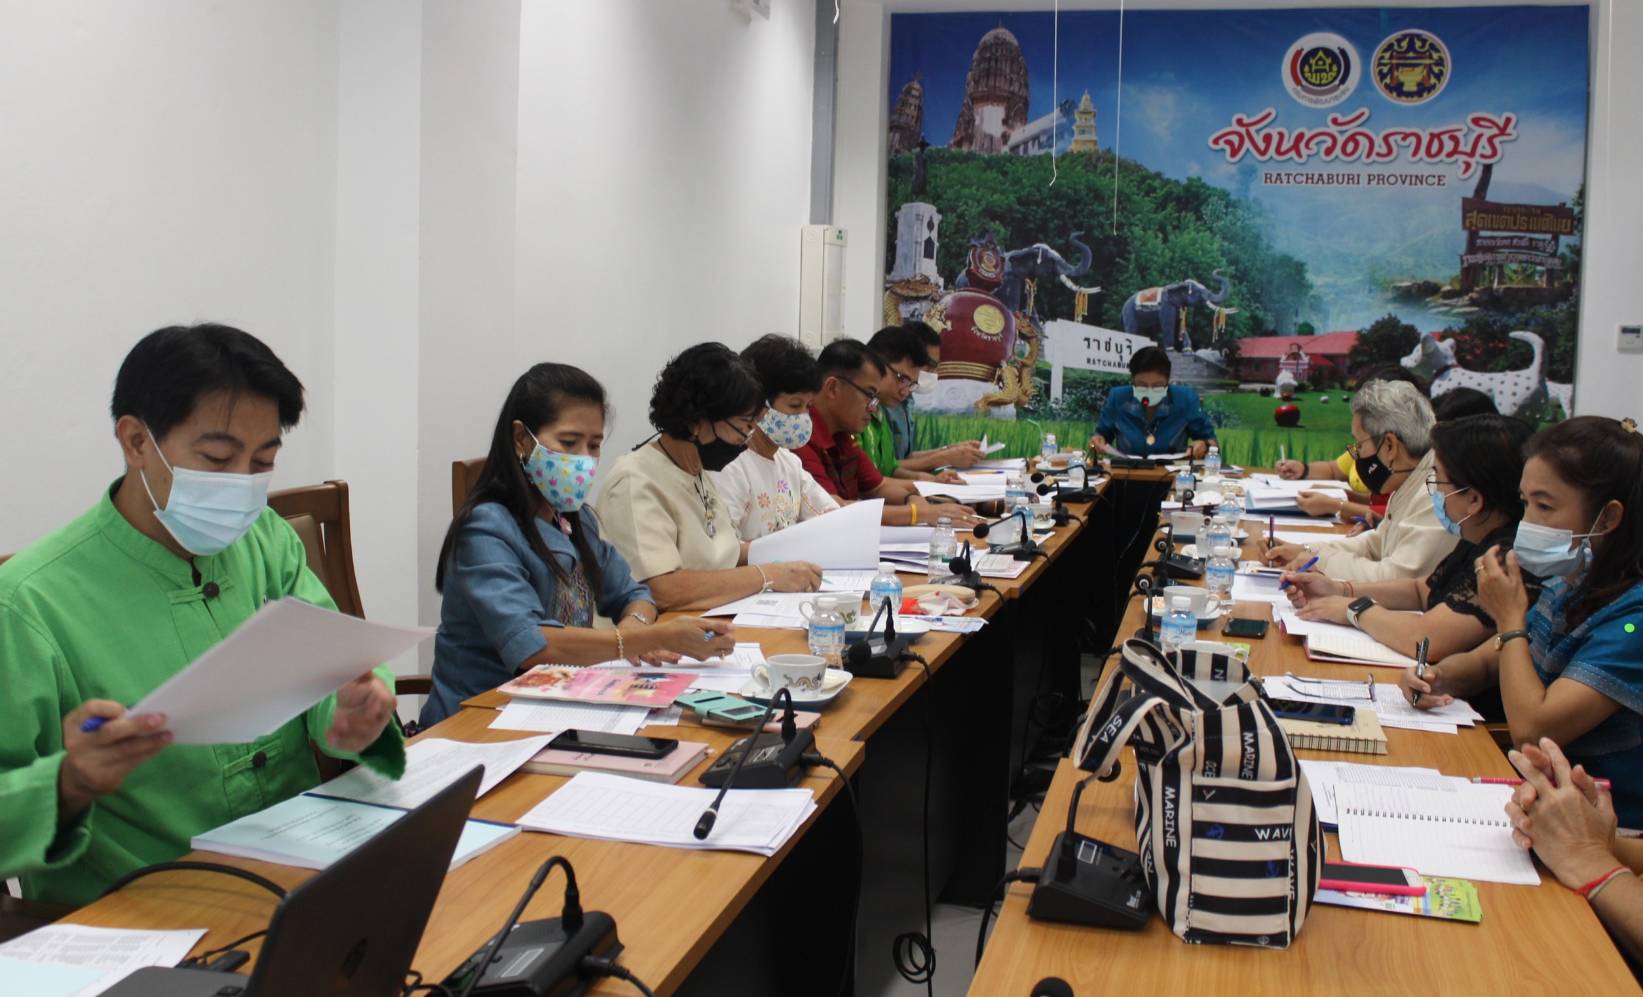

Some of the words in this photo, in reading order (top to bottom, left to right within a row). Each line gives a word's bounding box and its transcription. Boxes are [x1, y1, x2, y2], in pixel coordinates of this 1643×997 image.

[1210, 109, 1515, 177] จังหวัดราชบุรี
[1264, 172, 1361, 185] RATCHABURI
[1367, 173, 1446, 187] PROVINCE
[1100, 715, 1122, 743] SEA
[1240, 732, 1255, 781] MARINE
[1164, 786, 1177, 848] MARINE
